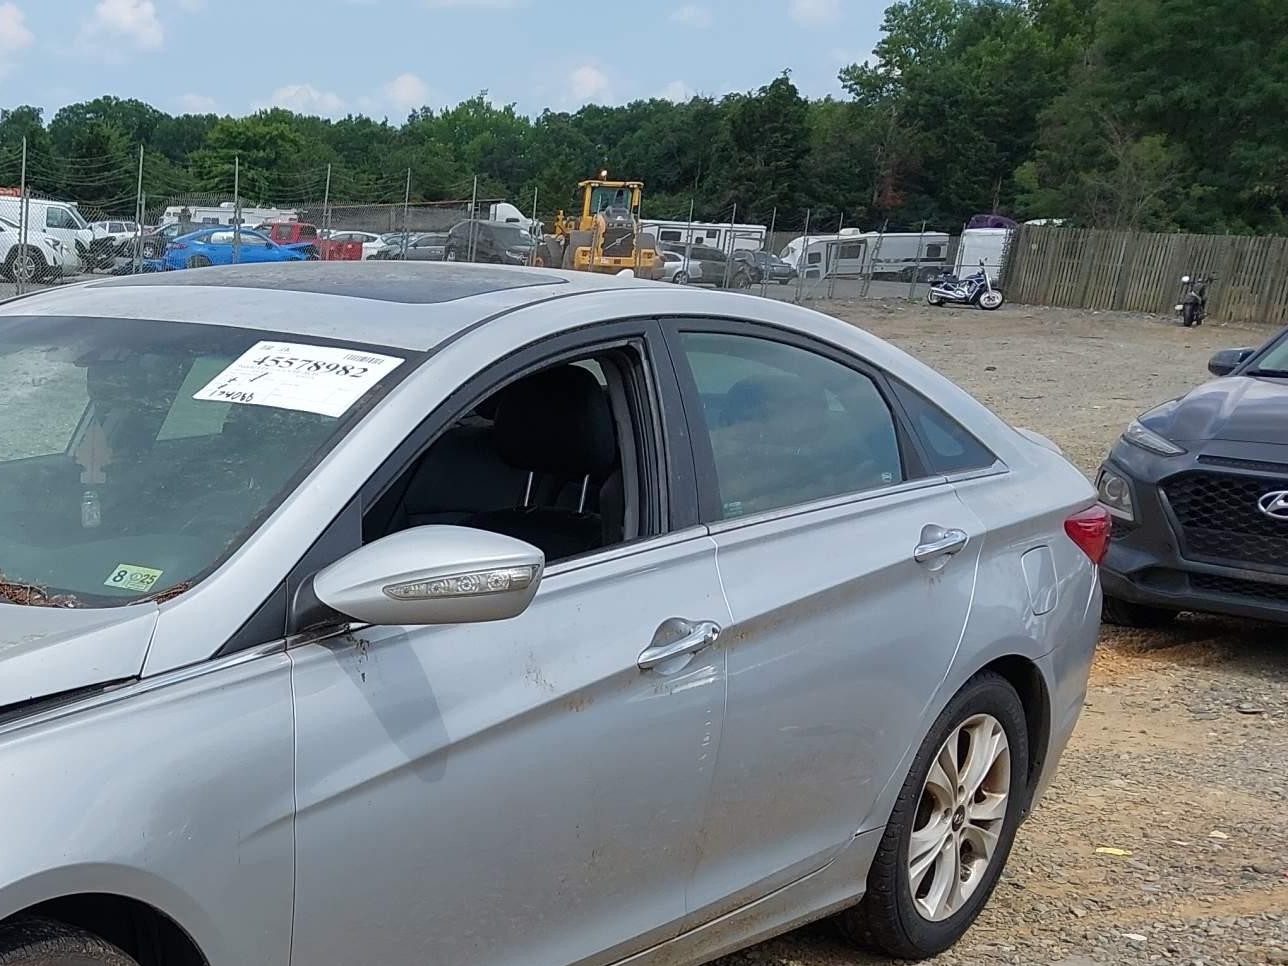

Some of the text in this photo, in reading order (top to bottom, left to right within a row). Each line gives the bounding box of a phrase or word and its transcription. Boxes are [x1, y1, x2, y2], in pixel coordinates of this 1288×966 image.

[253, 354, 368, 378] 45578982
[112, 570, 157, 585] 8 25
